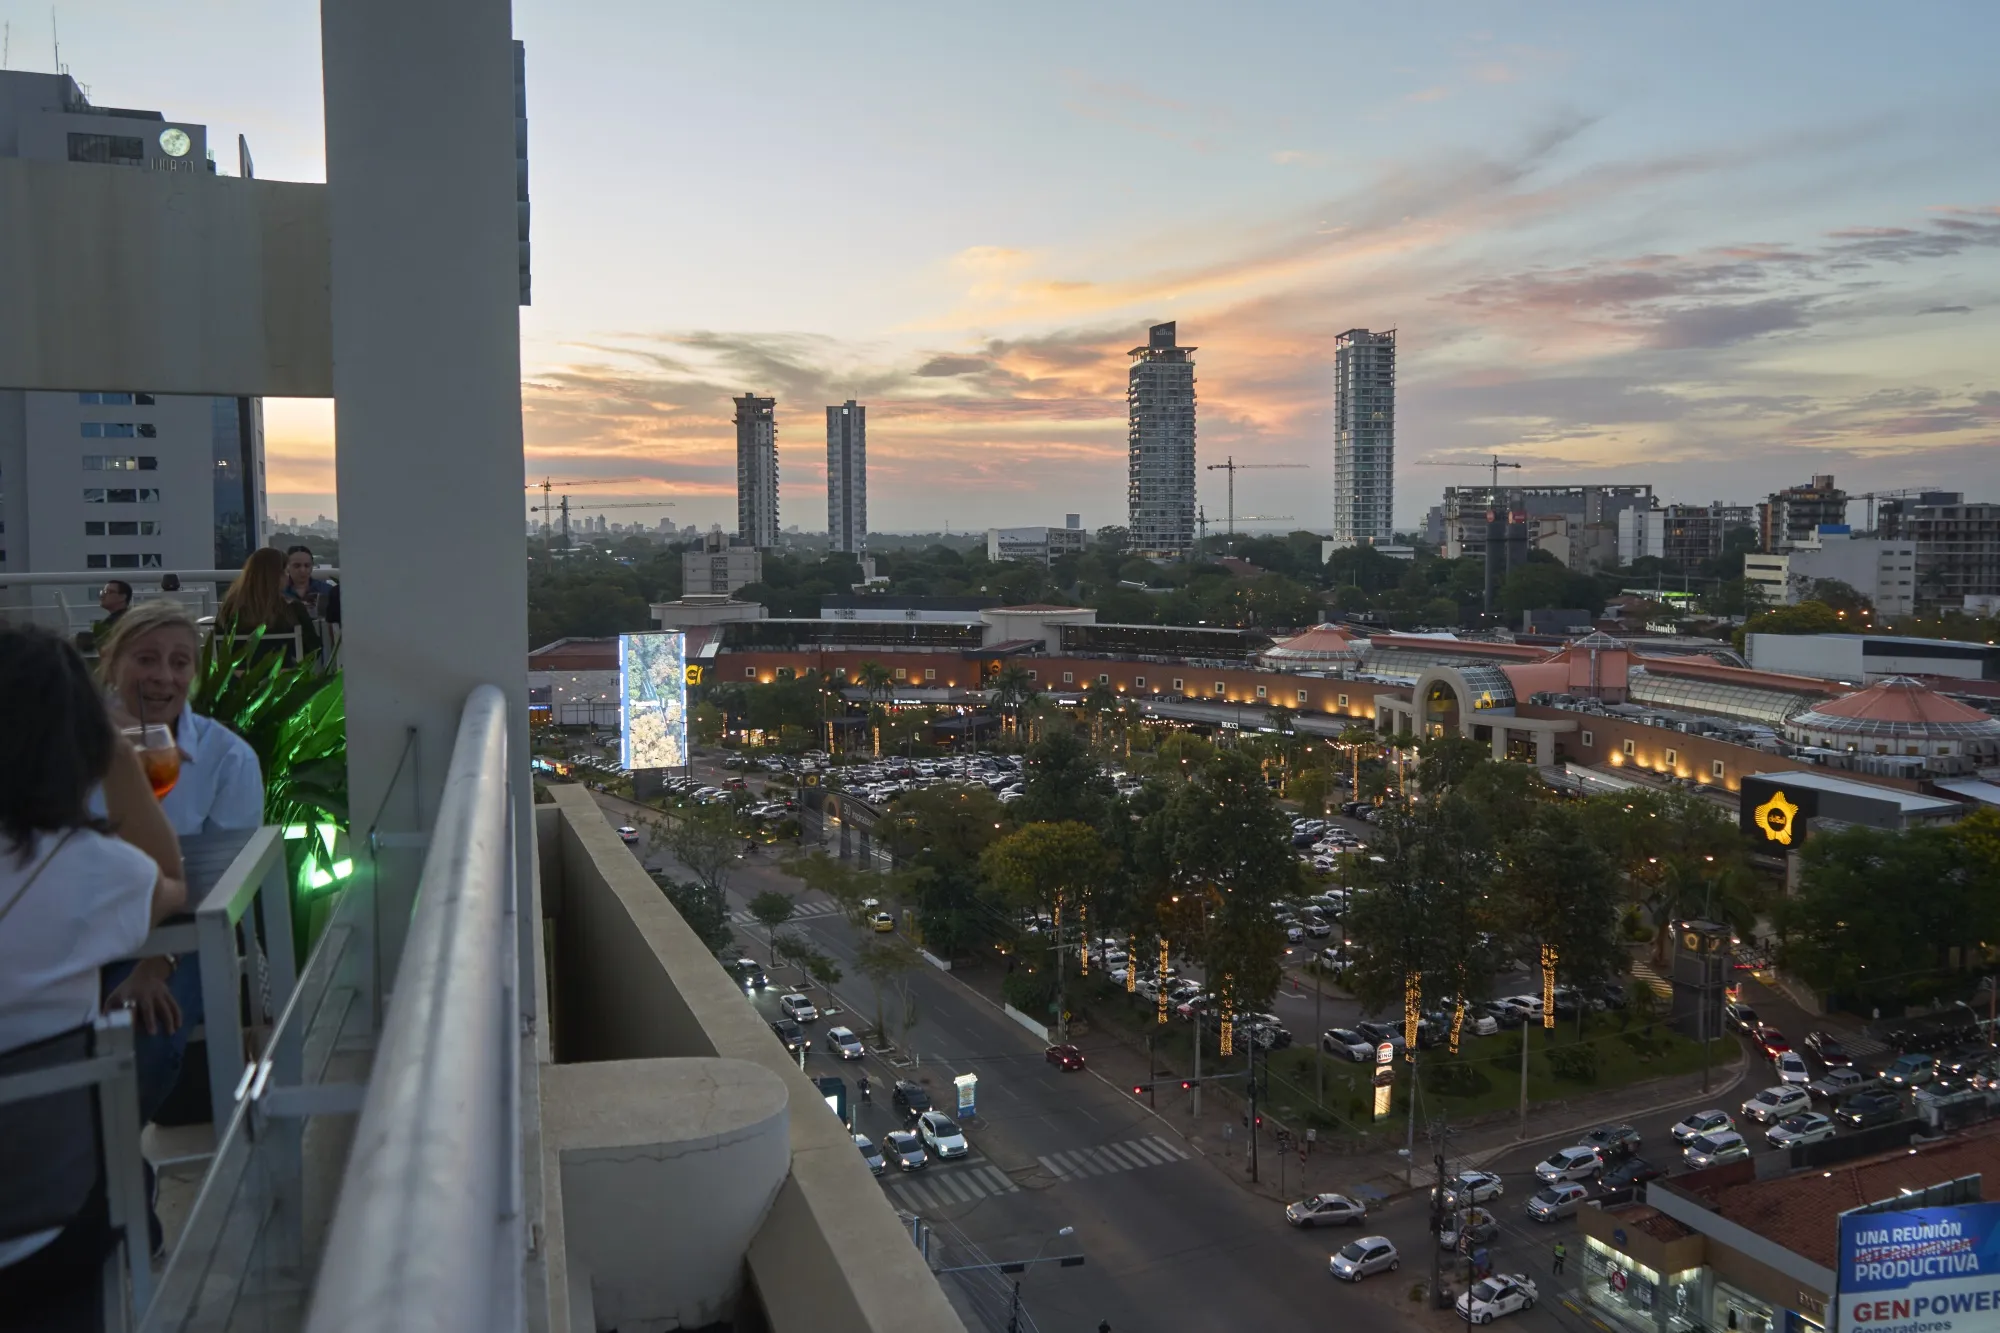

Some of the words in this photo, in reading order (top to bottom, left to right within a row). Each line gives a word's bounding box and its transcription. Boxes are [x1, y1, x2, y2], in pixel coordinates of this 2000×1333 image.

[1856, 1229, 1889, 1246] UNA
[1892, 1219, 1962, 1243] REUNIÓN
[1855, 1253, 1979, 1281] PRODUCTIVA
